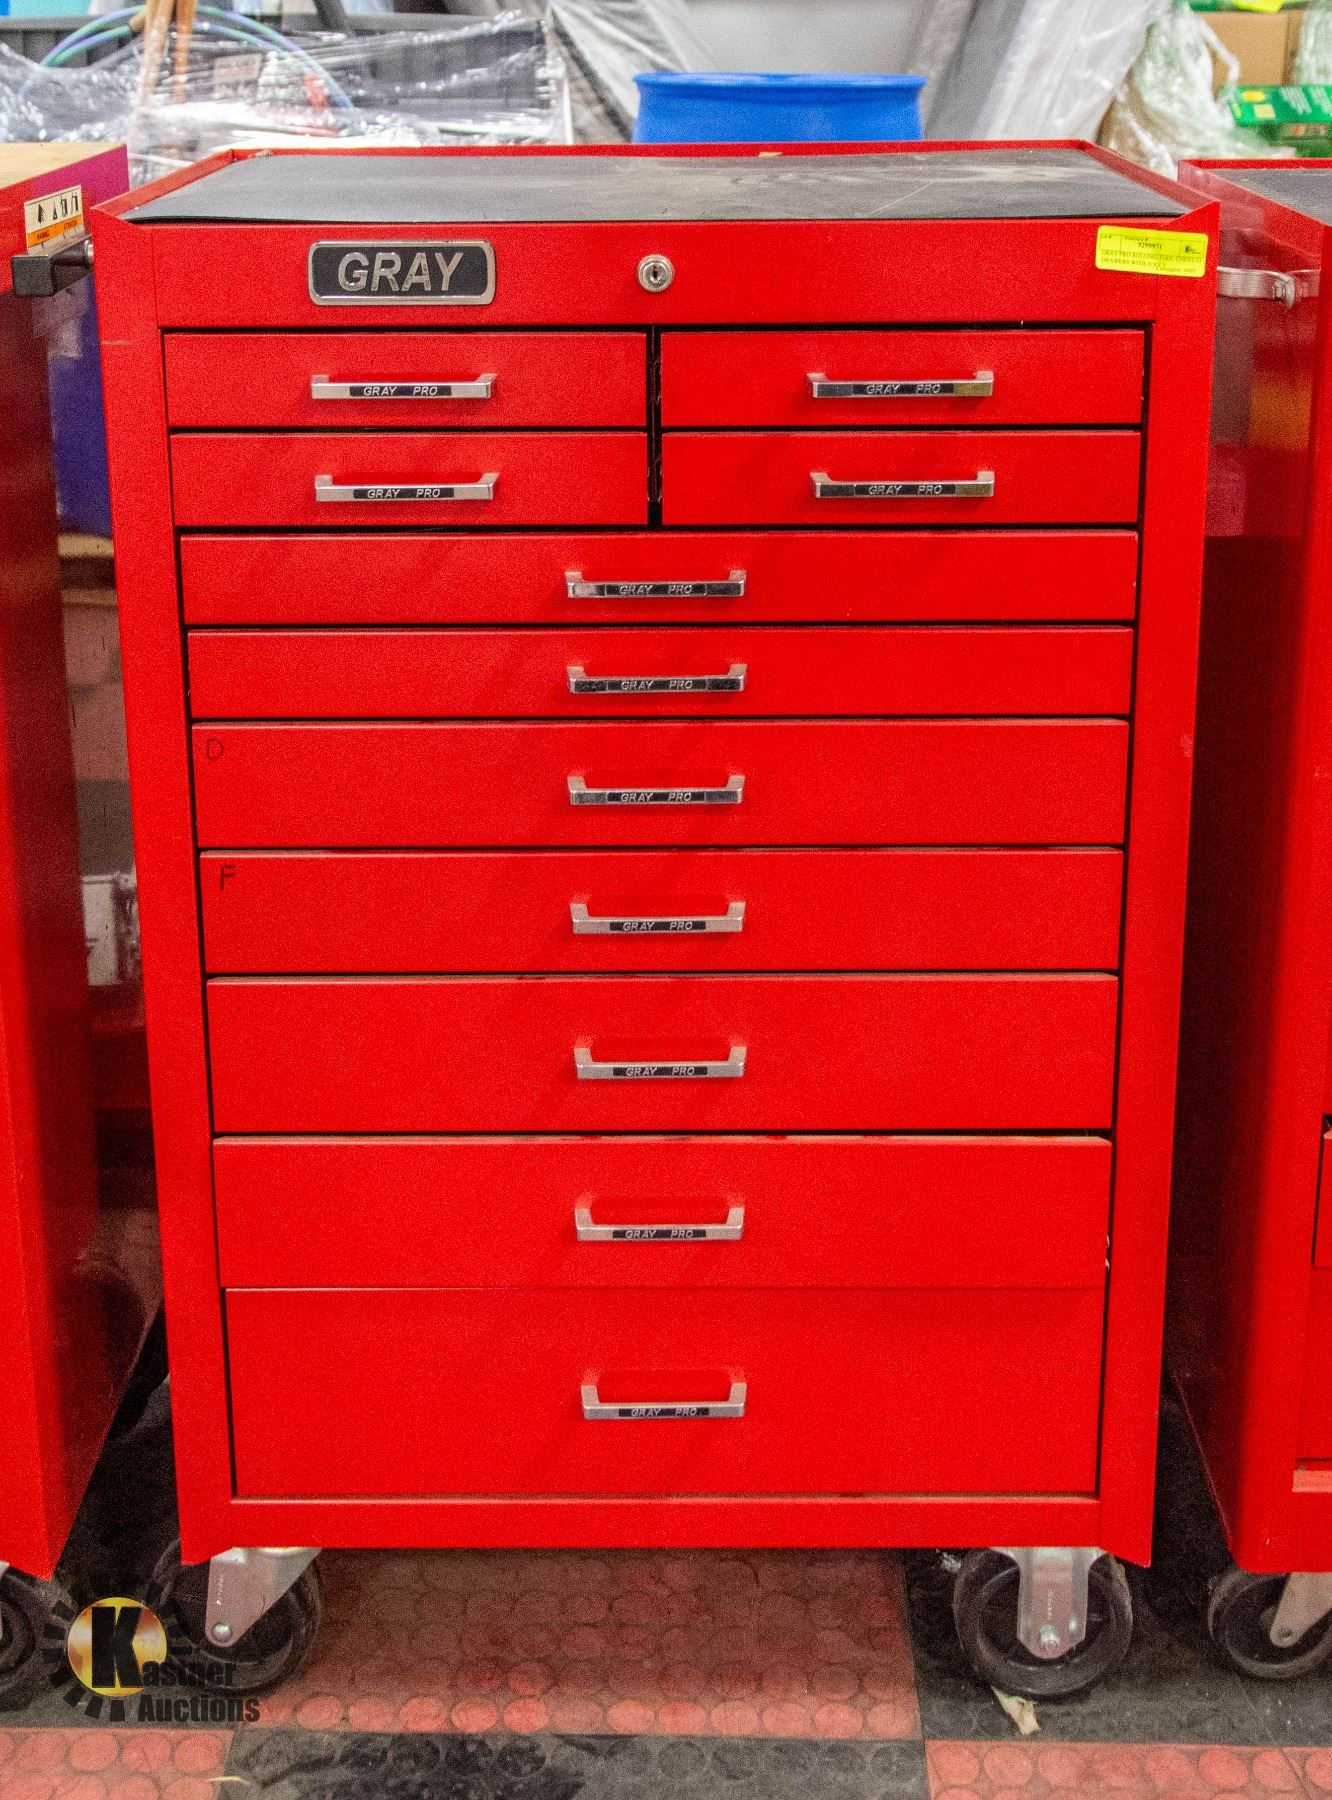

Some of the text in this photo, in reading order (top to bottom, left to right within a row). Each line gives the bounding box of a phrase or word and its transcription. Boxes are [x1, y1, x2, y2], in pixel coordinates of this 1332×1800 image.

[338, 252, 465, 292] GRAY
[363, 385, 438, 396] GRAY PRO
[866, 383, 941, 394] GRAY PRO
[367, 488, 441, 499] GRAY PRO
[869, 484, 943, 495] GRAY PRO
[620, 584, 692, 594] GRAY PRO
[621, 680, 693, 690] GRAY PRO
[621, 791, 692, 802] GRAY PRO
[219, 864, 237, 891] F
[622, 921, 693, 931] GRAY PRO
[625, 1066, 695, 1076] GRAY PRO
[625, 1229, 694, 1239] GRAY PRO
[631, 1407, 697, 1417] GRAY PRO
